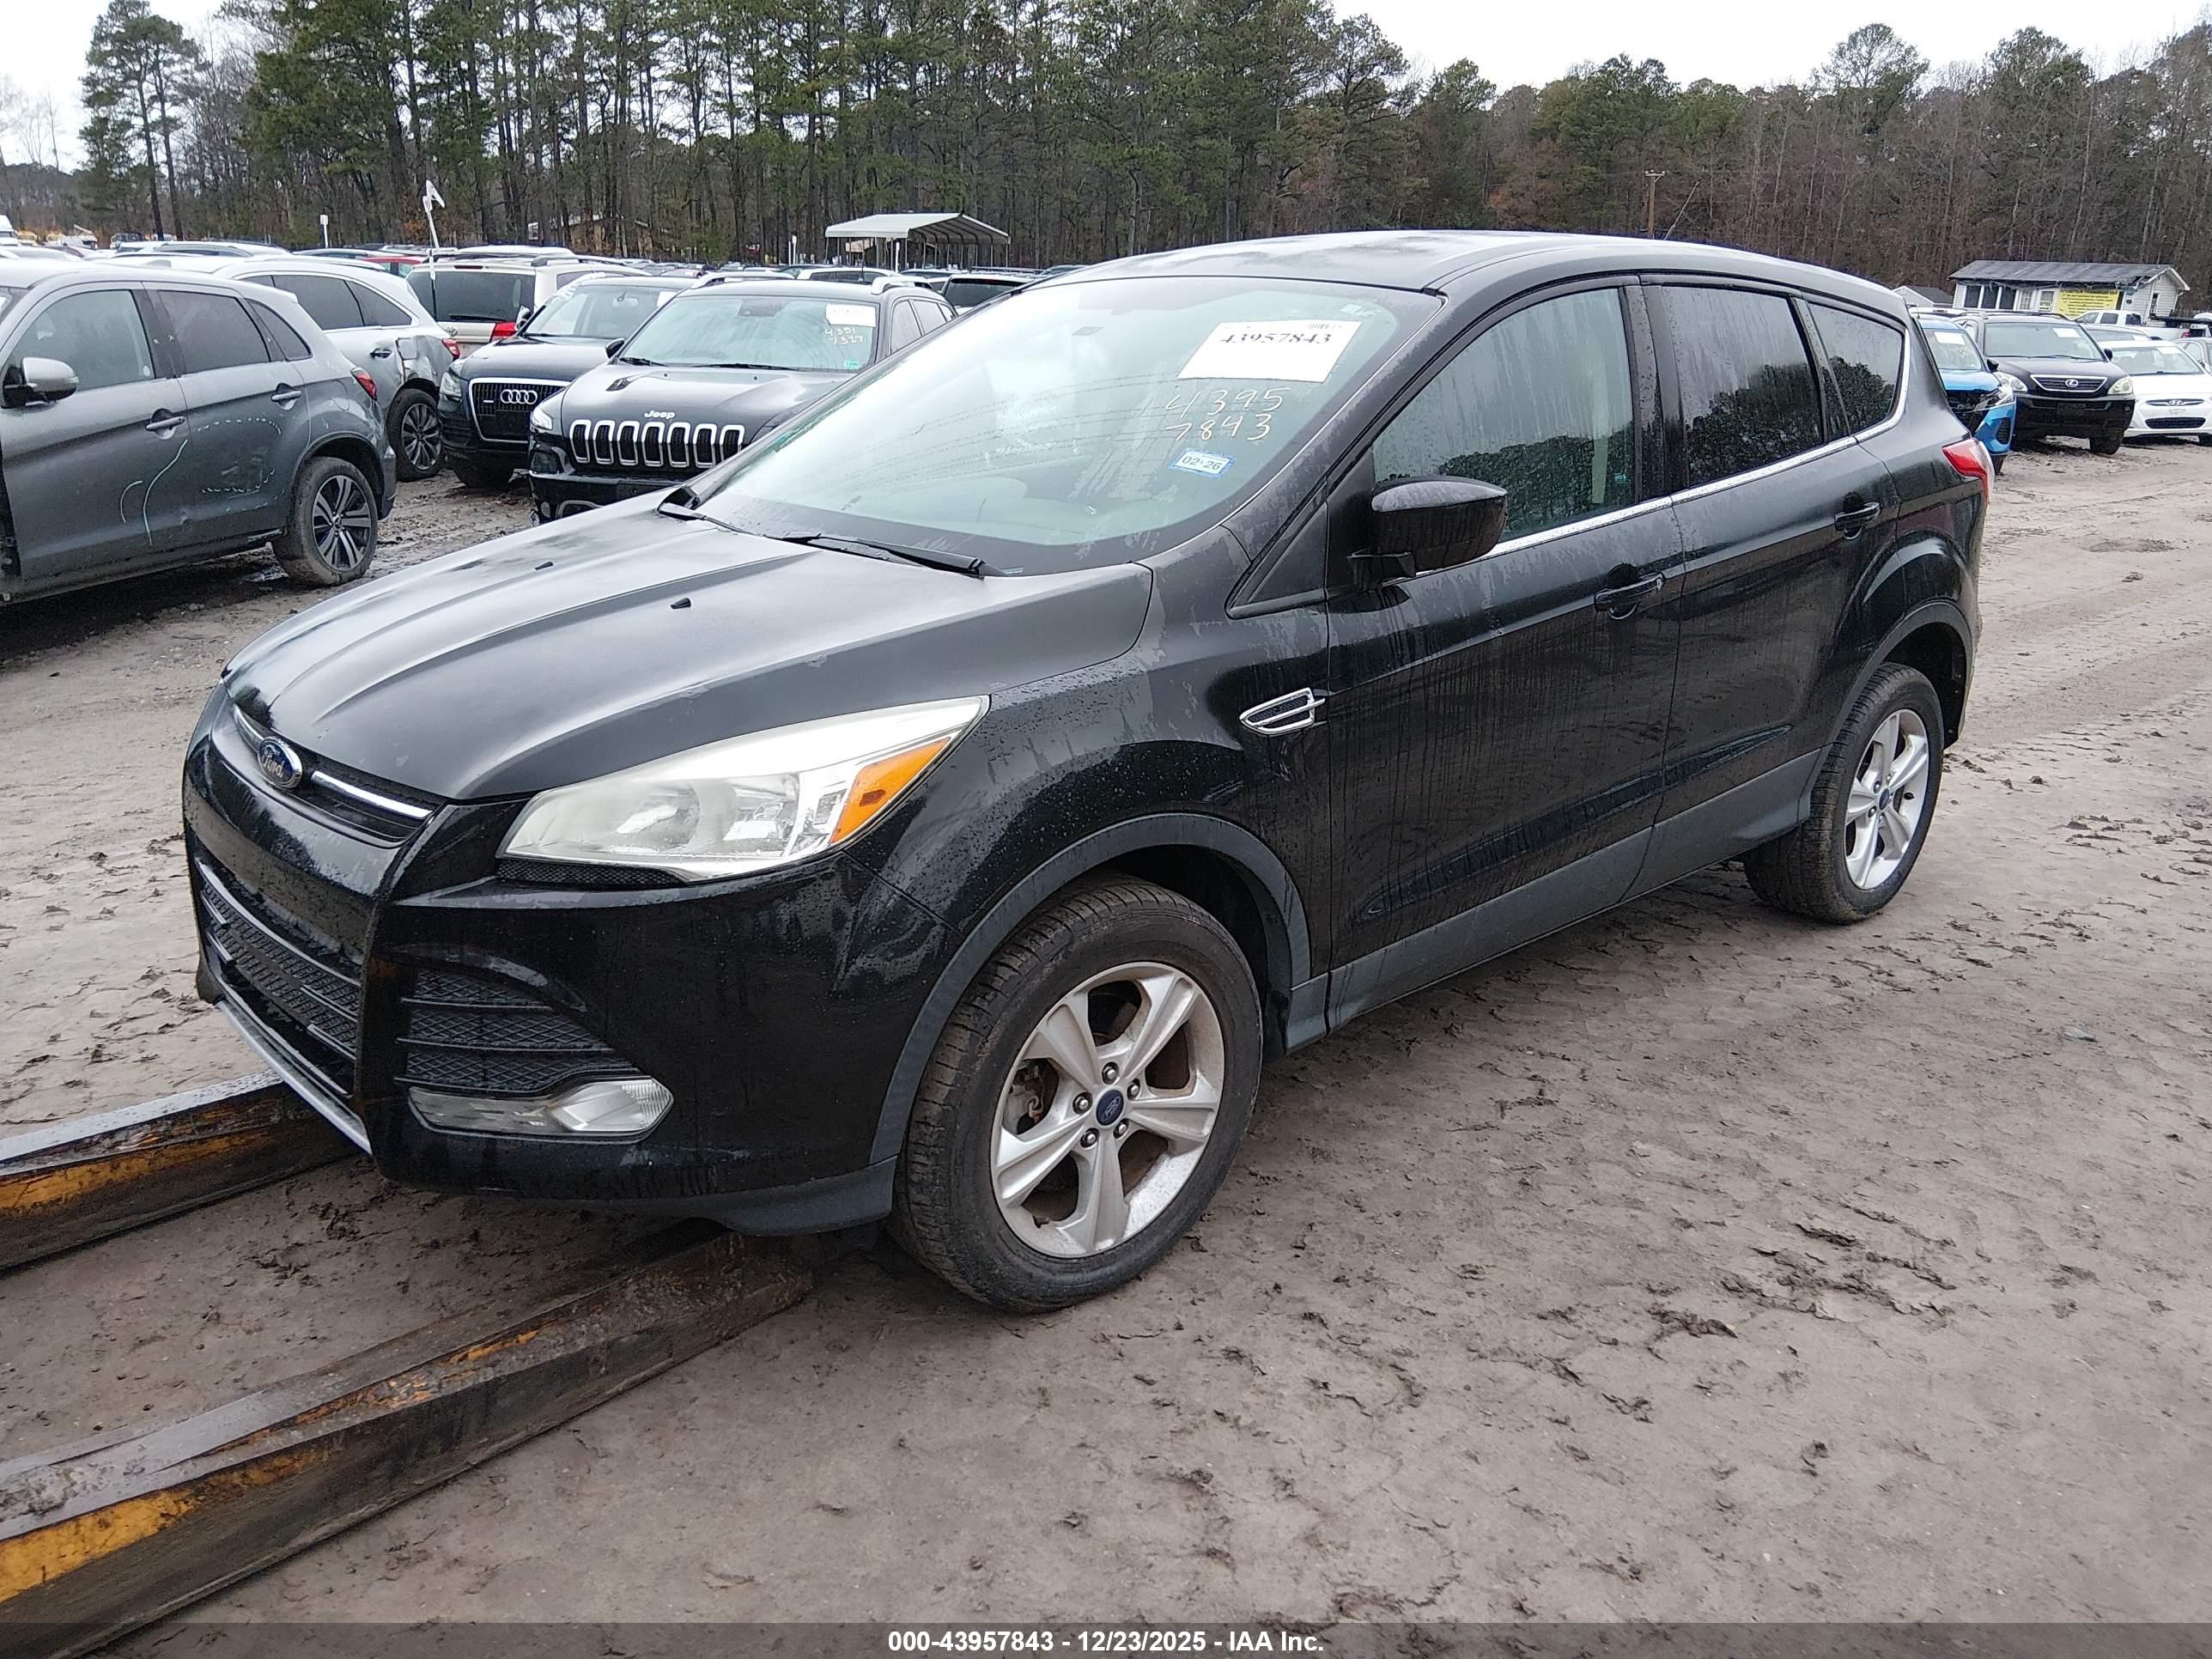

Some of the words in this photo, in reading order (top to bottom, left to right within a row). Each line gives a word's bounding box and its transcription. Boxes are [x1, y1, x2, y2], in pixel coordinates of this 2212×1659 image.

[1220, 332, 1333, 344] 43957843
[644, 410, 676, 420] Jeep
[1164, 387, 1291, 419] 4395
[1164, 413, 1272, 441] 7843
[262, 744, 286, 778] Ford
